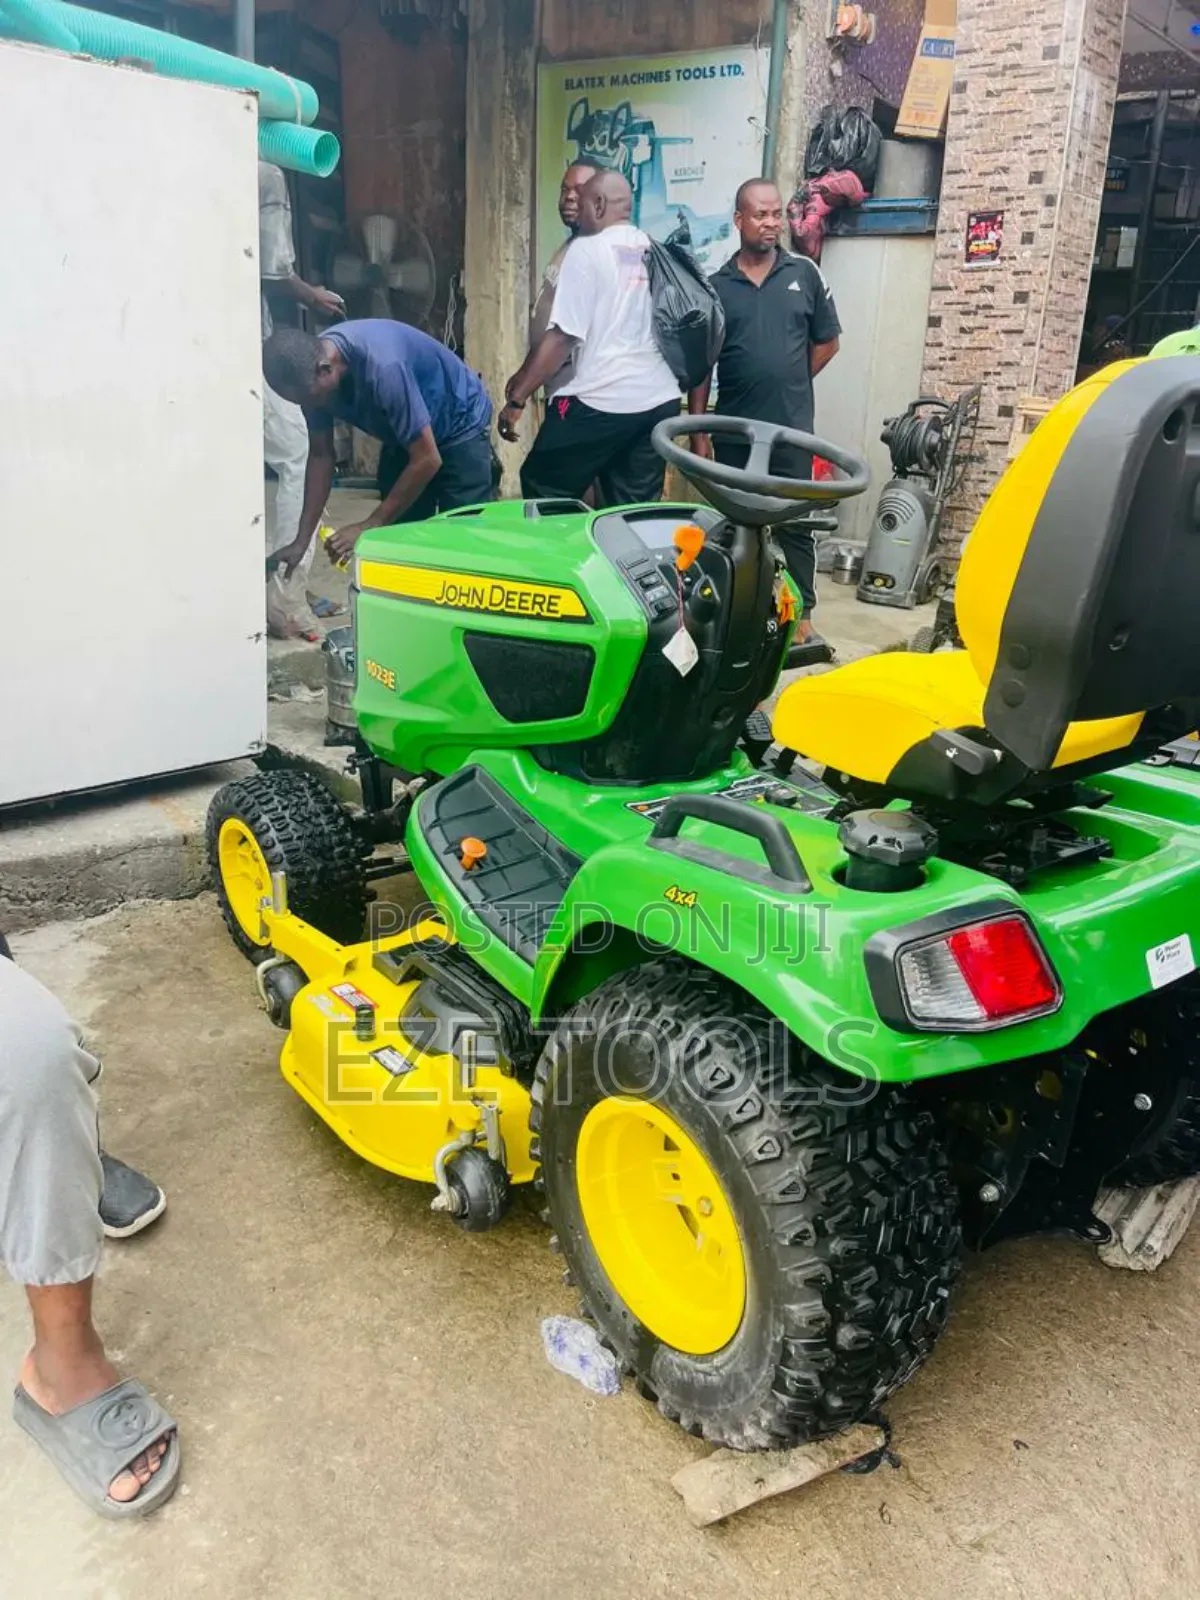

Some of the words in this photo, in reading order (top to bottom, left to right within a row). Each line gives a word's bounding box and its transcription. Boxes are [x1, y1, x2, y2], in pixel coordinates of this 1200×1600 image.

[610, 70, 671, 88] MACHINES
[676, 66, 716, 81] TOOLS
[720, 63, 745, 77] LTD.
[435, 580, 485, 605] JOHN
[488, 584, 562, 614] DEERE
[365, 657, 397, 691] 1023E
[664, 885, 698, 908] 4x4
